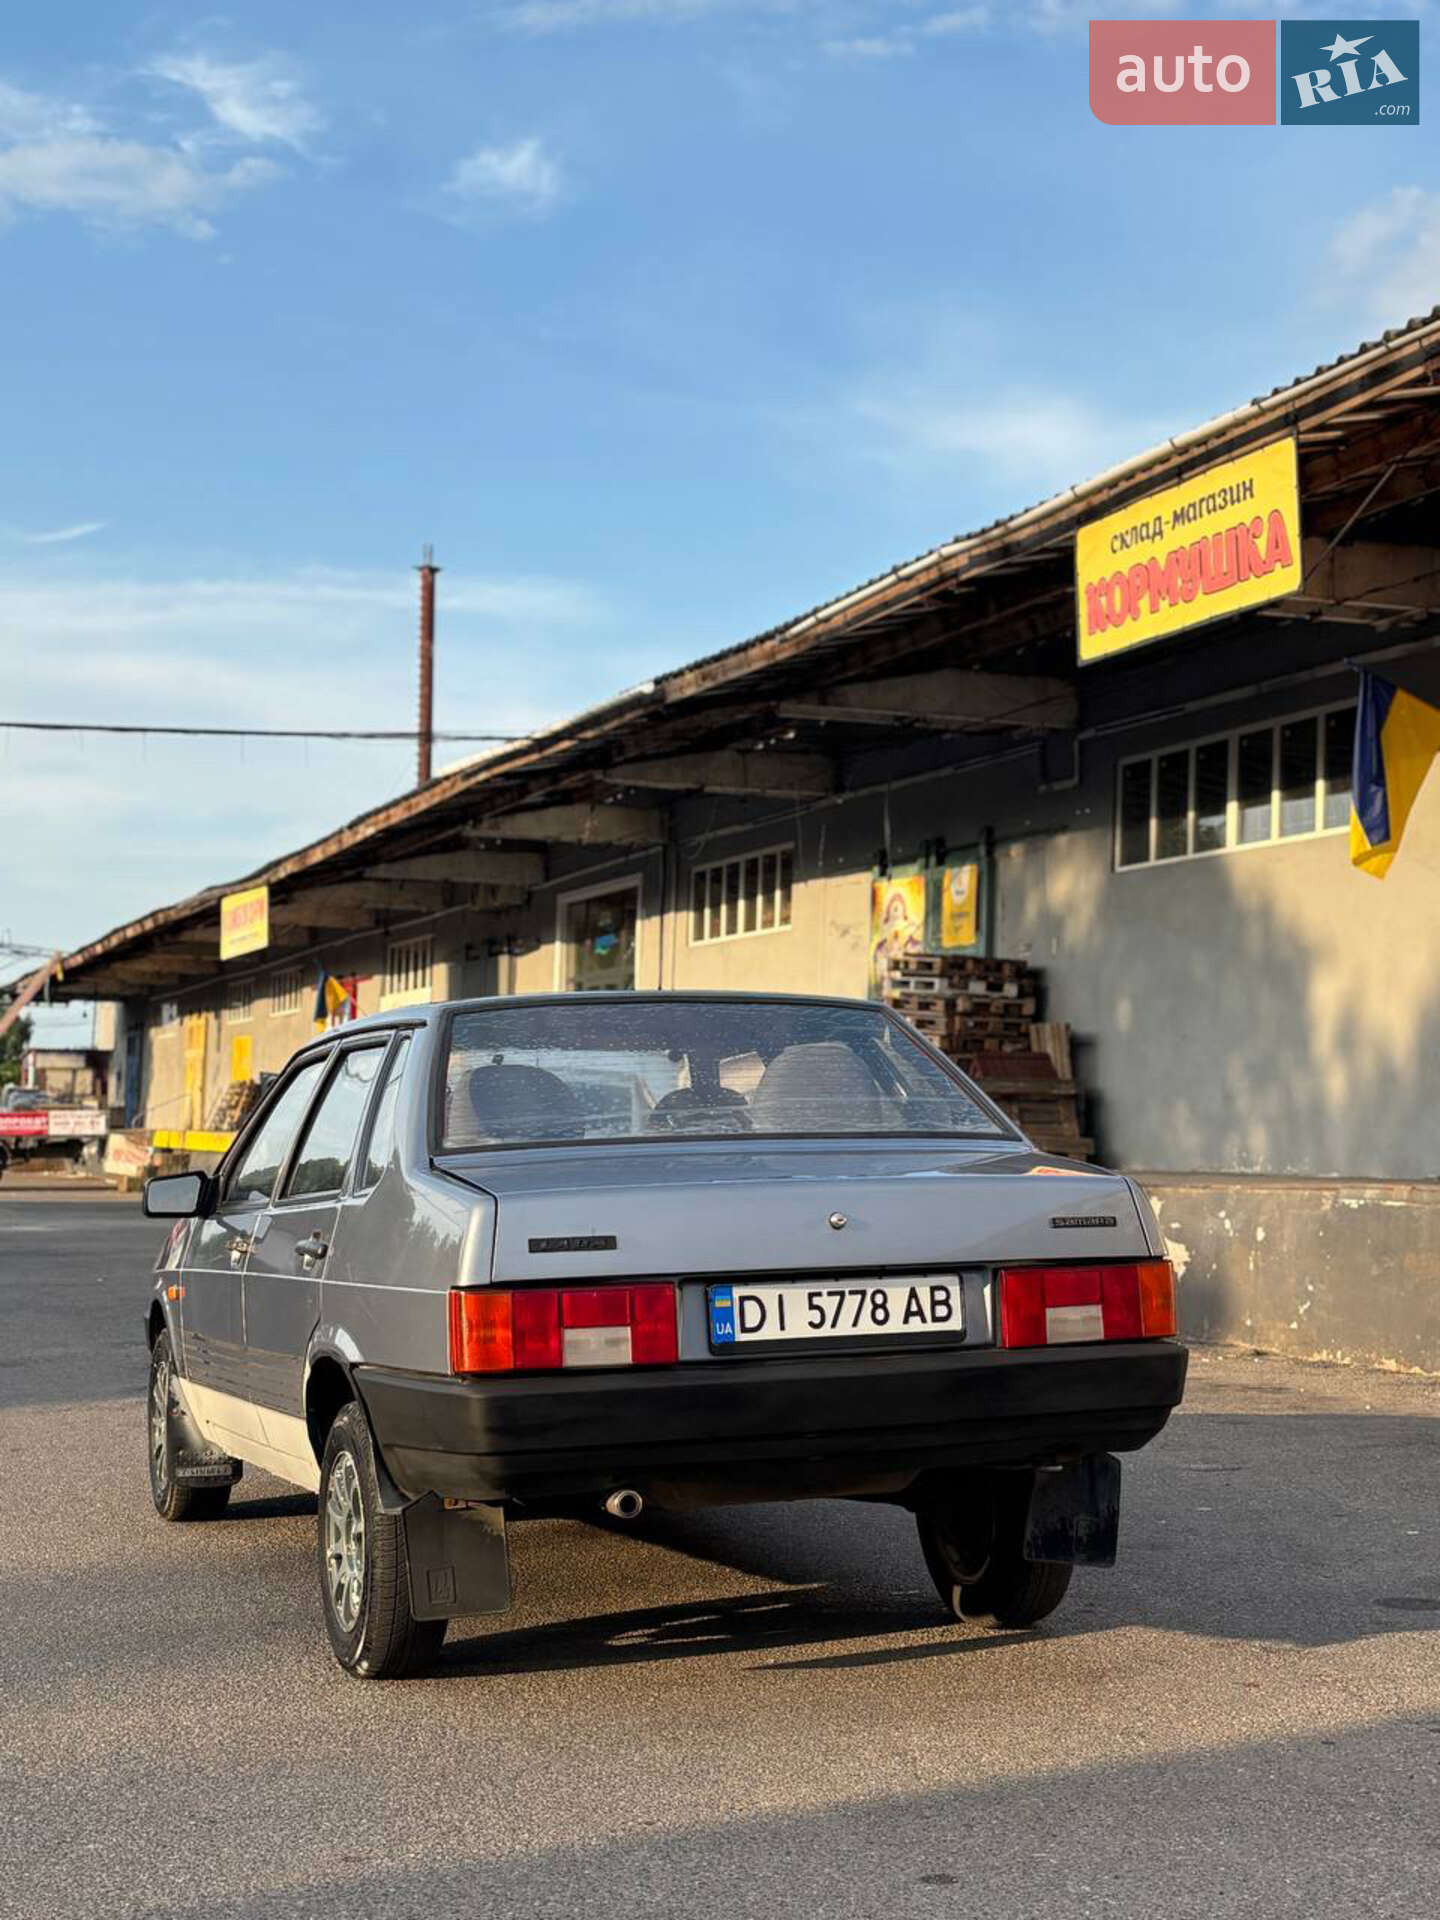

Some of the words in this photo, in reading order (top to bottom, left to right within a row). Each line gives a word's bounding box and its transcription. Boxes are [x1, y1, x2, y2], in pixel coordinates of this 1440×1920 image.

[1110, 478, 1255, 554] склад-магазин
[1085, 509, 1293, 636] КОРМУШКА
[715, 1322, 733, 1336] UA
[738, 1293, 786, 1334] DI
[807, 1289, 890, 1329] 5778
[902, 1285, 952, 1325] AB
